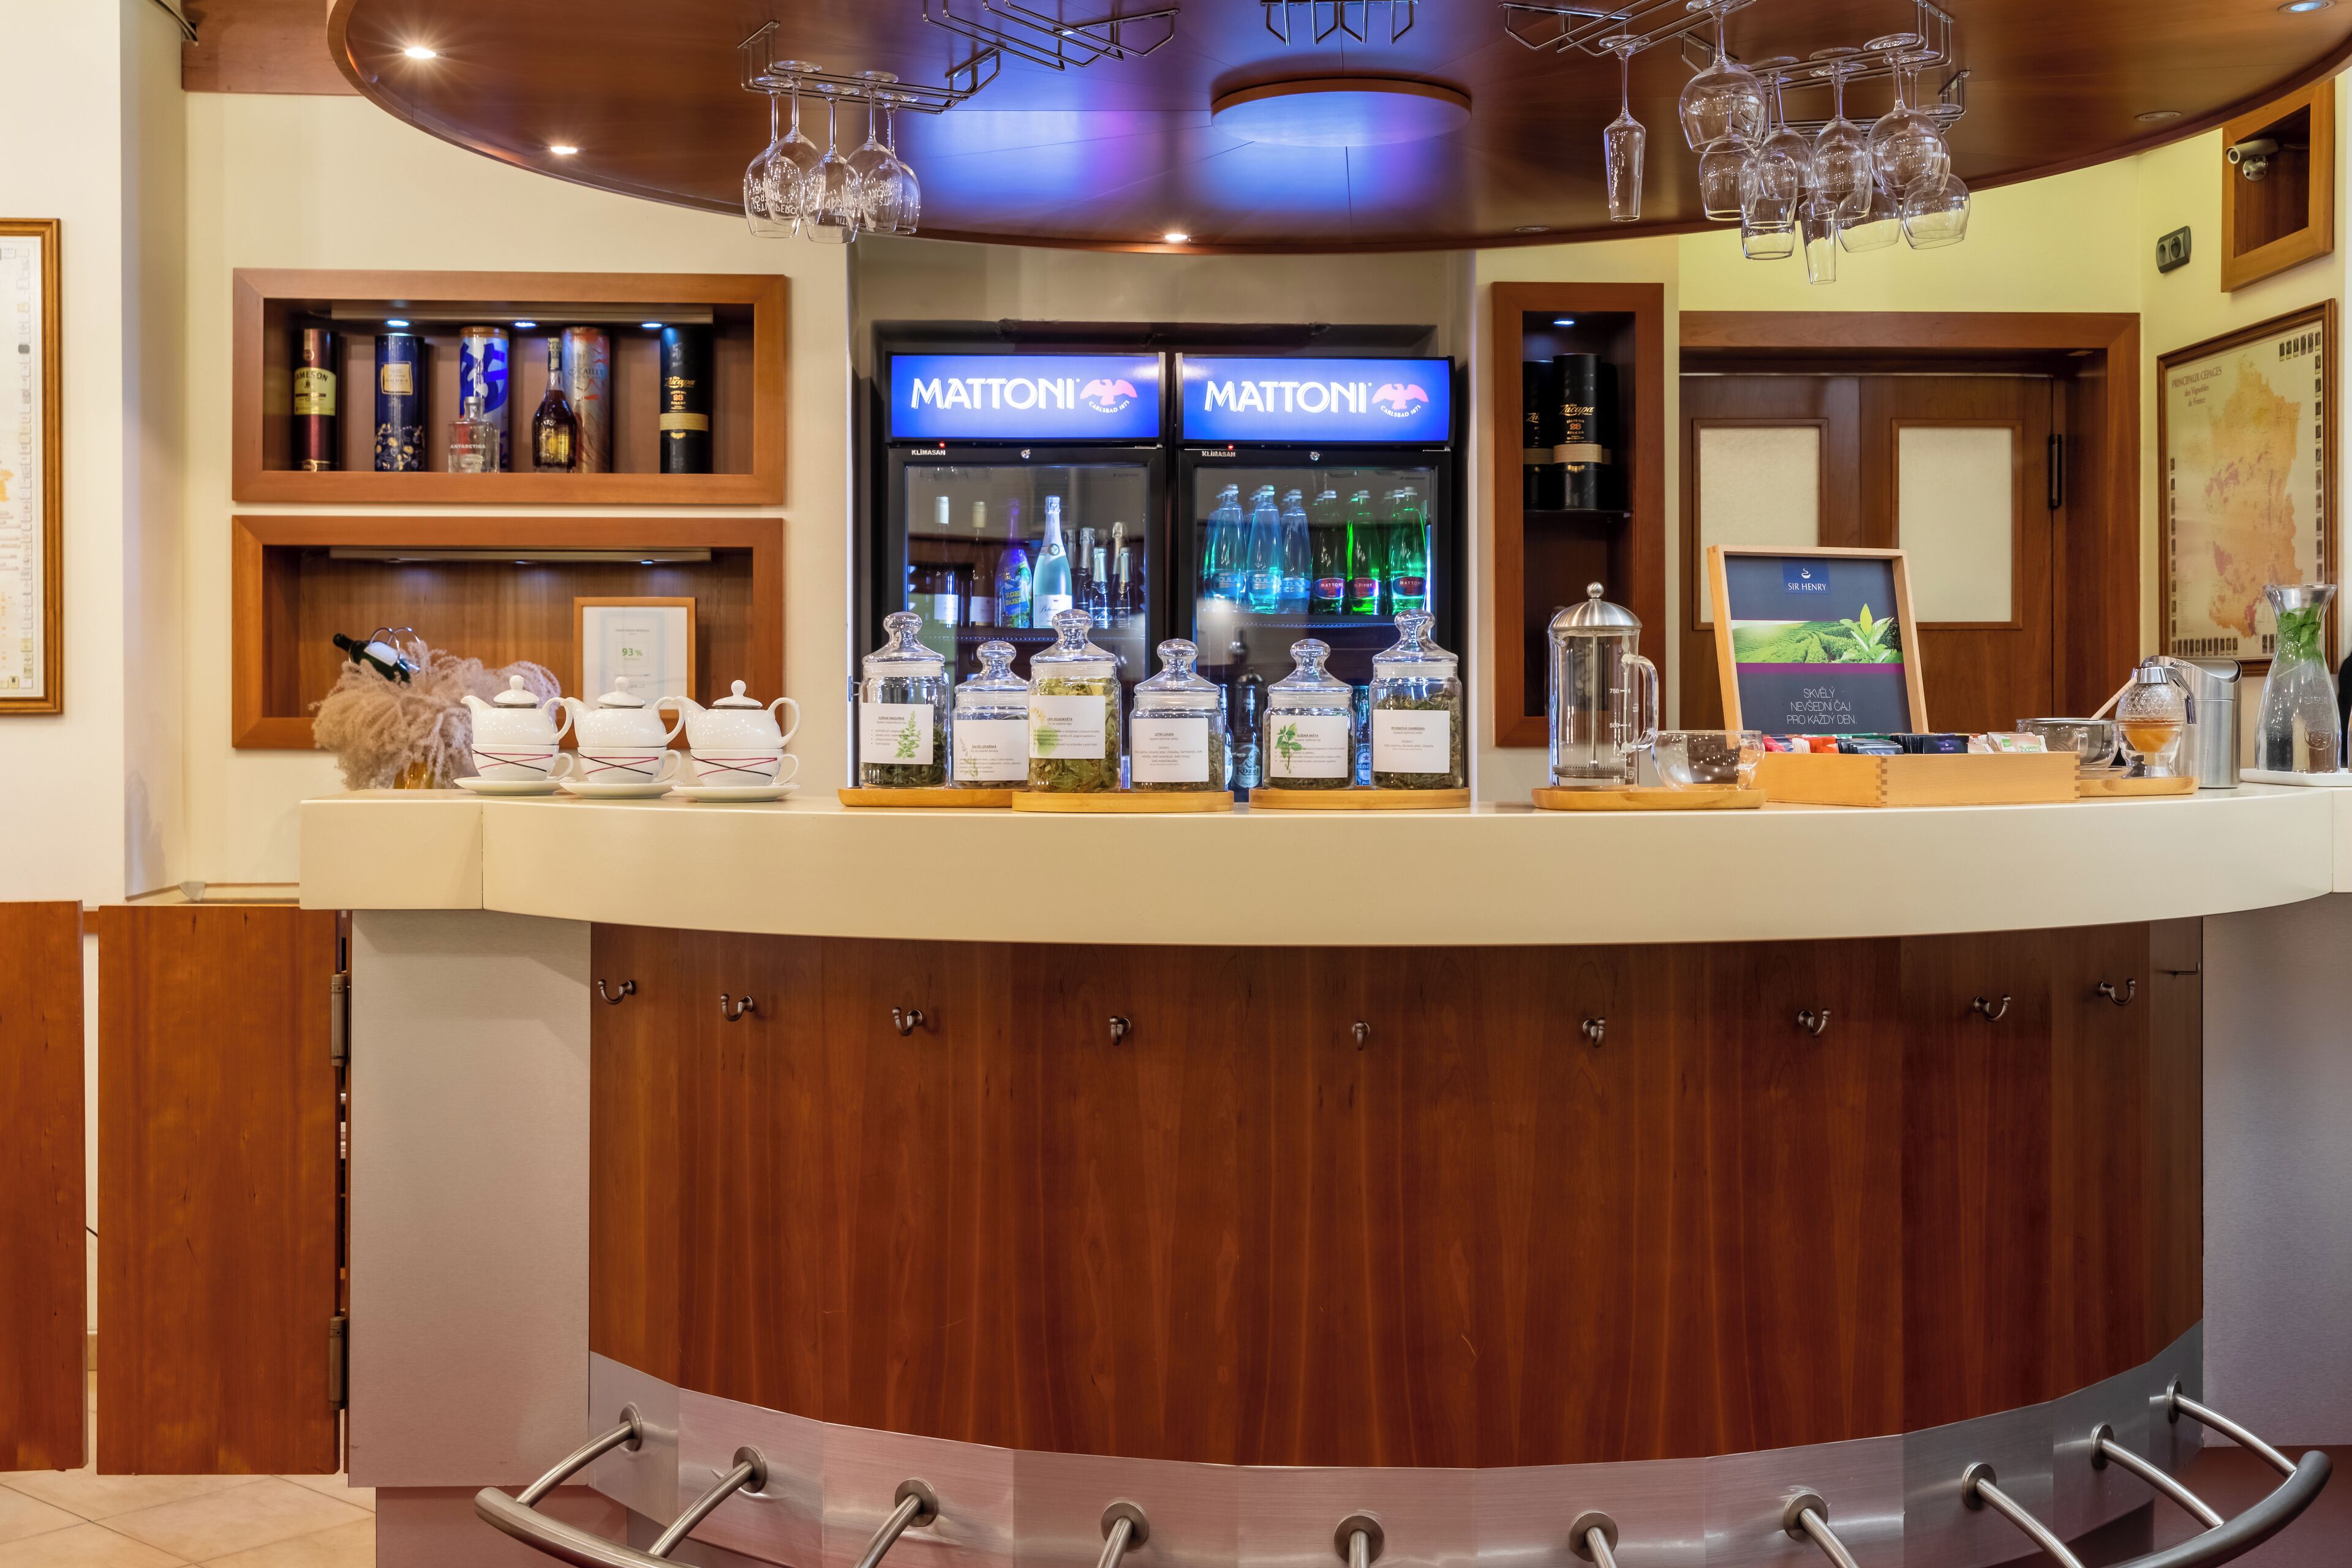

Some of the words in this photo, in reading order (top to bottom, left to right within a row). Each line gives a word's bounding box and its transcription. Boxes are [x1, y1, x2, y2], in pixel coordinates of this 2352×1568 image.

[911, 377, 1074, 410] MATTONI
[1204, 380, 1366, 413] MATTONI
[1088, 401, 1118, 413] CARLSBAD
[1119, 399, 1130, 410] 1873
[1380, 404, 1409, 418] CARLSBAD
[1410, 404, 1422, 415] 1873
[1559, 404, 1595, 417] Zacapa
[622, 647, 633, 656] 93
[1803, 686, 1835, 698] SKVĚLÝ
[1791, 699, 1832, 712] NEVŠEDNÍ
[1834, 699, 1851, 712] ČAJ
[1787, 715, 1806, 725] PRO
[1807, 712, 1835, 725] KAŽDÝ
[1838, 715, 1857, 725] DEN.
[1236, 766, 1259, 776] Kozel
